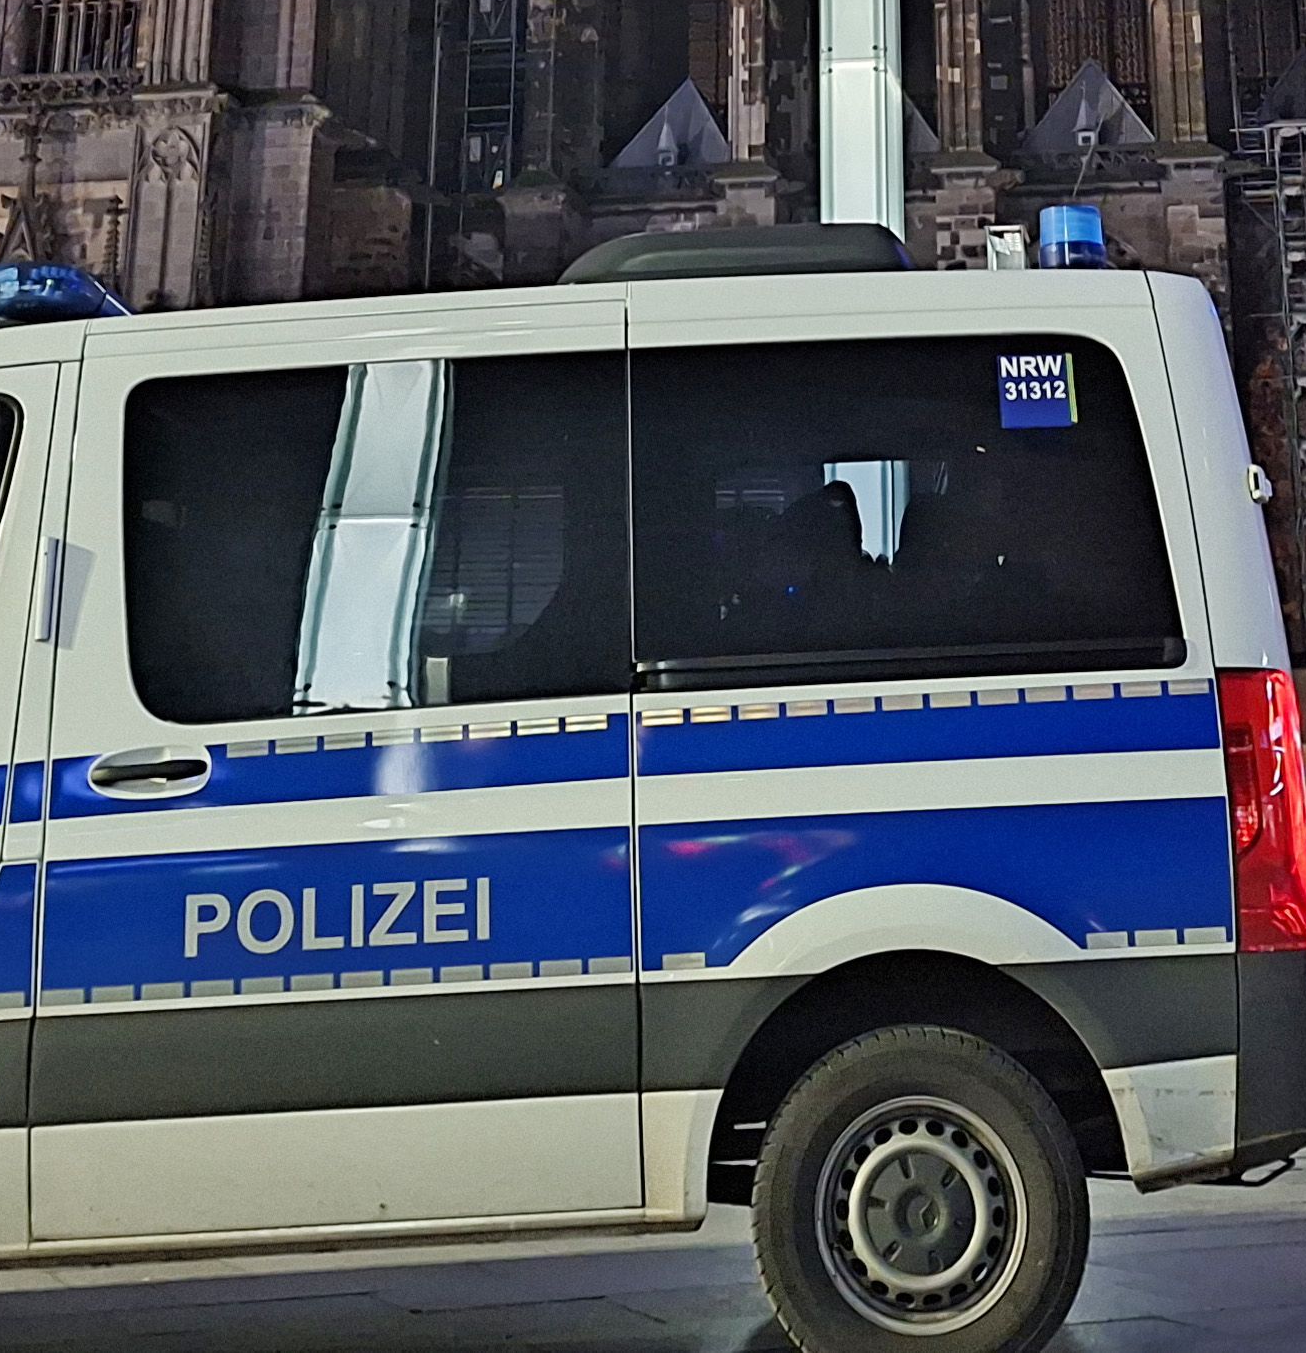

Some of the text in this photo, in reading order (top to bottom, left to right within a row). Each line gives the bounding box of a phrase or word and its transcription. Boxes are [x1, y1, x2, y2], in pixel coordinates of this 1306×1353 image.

[999, 355, 1063, 378] NRW
[1005, 380, 1067, 401] 31312
[183, 877, 490, 958] POLIZEI
